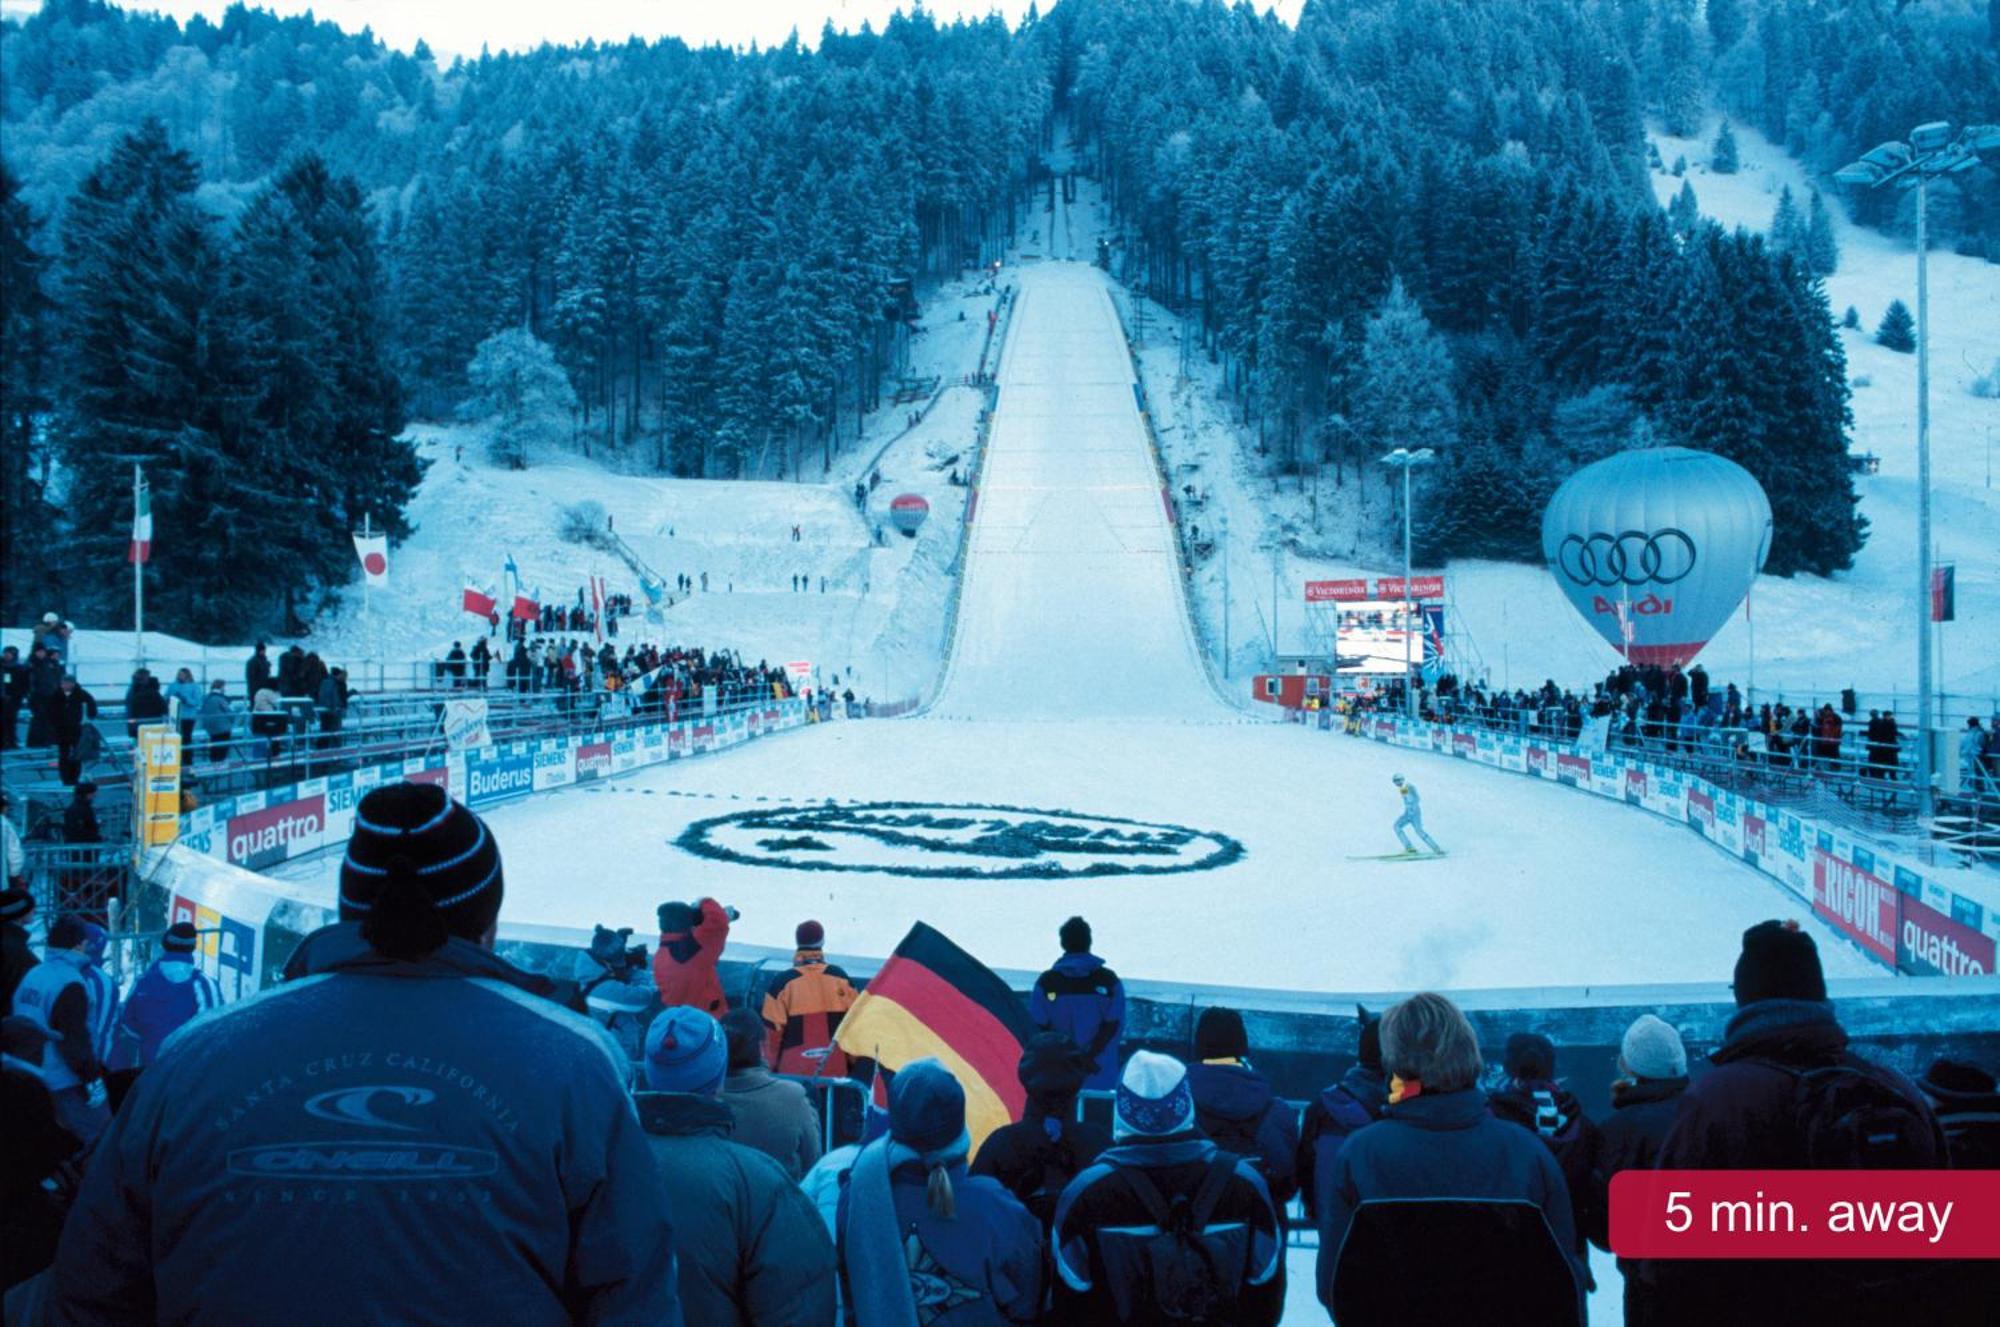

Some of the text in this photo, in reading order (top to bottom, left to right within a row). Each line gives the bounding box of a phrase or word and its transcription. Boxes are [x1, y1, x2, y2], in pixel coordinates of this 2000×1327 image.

[470, 767, 531, 796] Buderus
[232, 814, 319, 864] quattro
[1825, 857, 1880, 941] RICOH
[305, 1052, 373, 1076] CRUZ
[386, 1052, 520, 1133] CALIFORNIA
